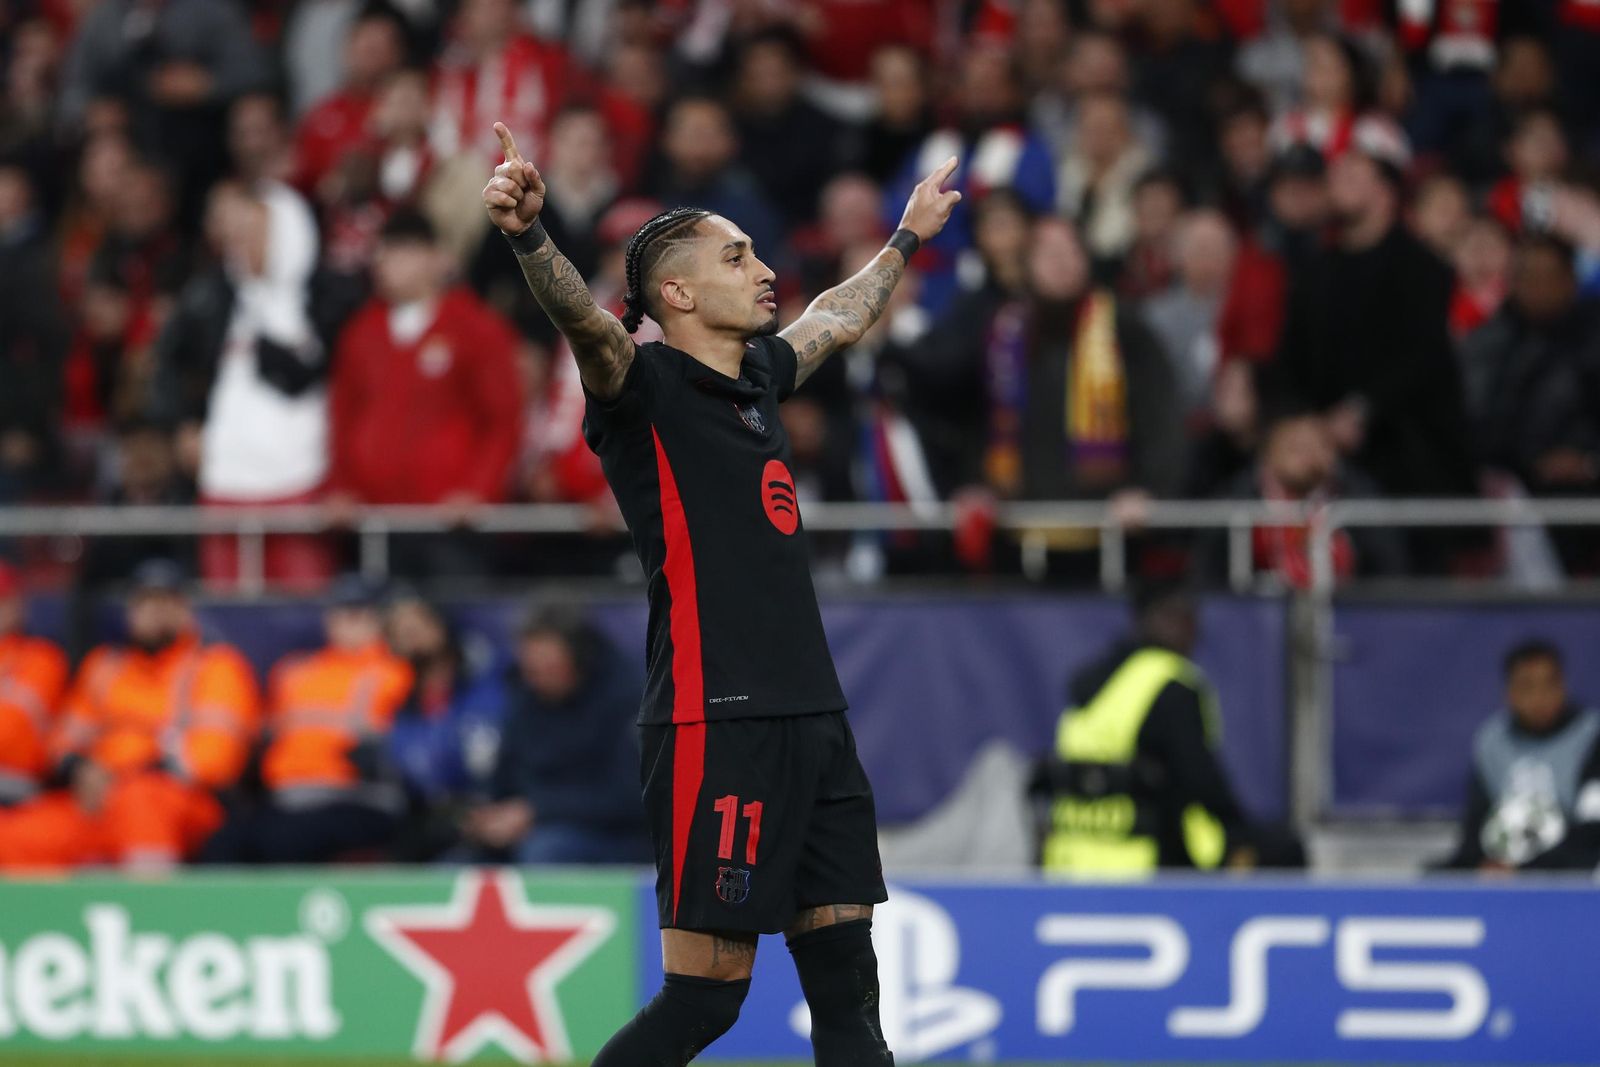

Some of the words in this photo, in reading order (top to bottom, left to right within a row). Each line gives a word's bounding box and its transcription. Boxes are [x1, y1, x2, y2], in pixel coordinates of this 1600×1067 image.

[713, 794, 764, 866] 11
[0, 903, 342, 1039] eken
[1036, 914, 1490, 1039] PS5
